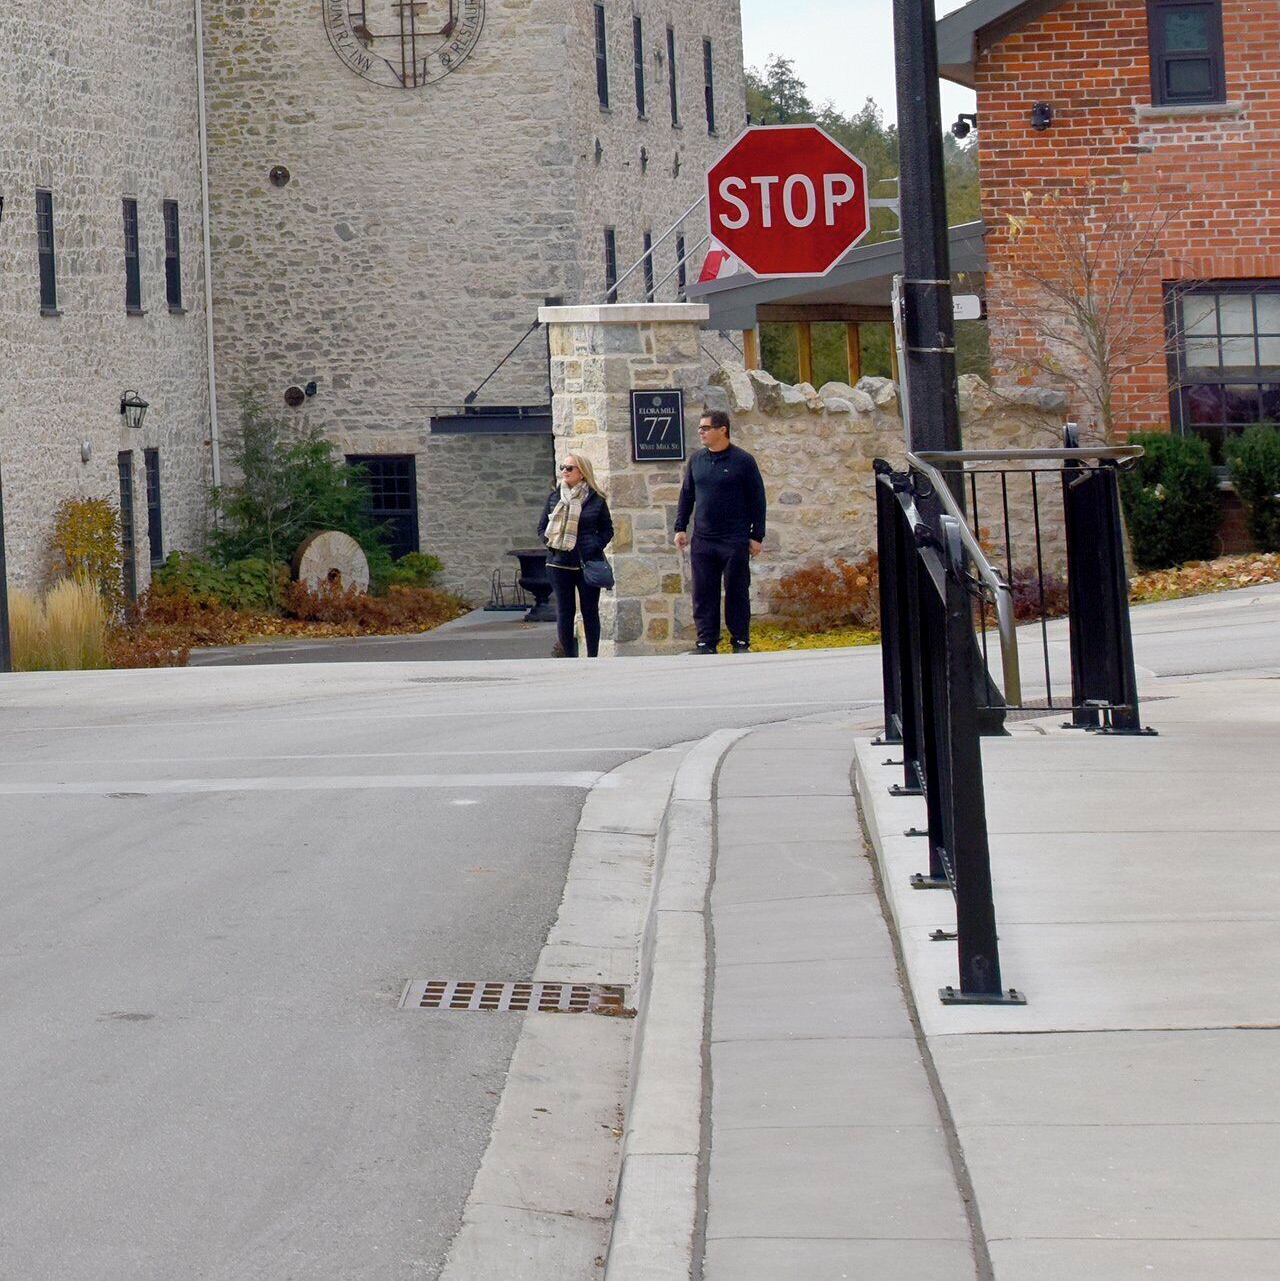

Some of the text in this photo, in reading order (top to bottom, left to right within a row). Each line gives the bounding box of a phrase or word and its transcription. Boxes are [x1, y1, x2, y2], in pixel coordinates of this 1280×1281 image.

[350, 48, 373, 70] INN
[439, 52, 452, 66] &
[718, 173, 855, 229] STOP
[644, 417, 672, 441] 77
